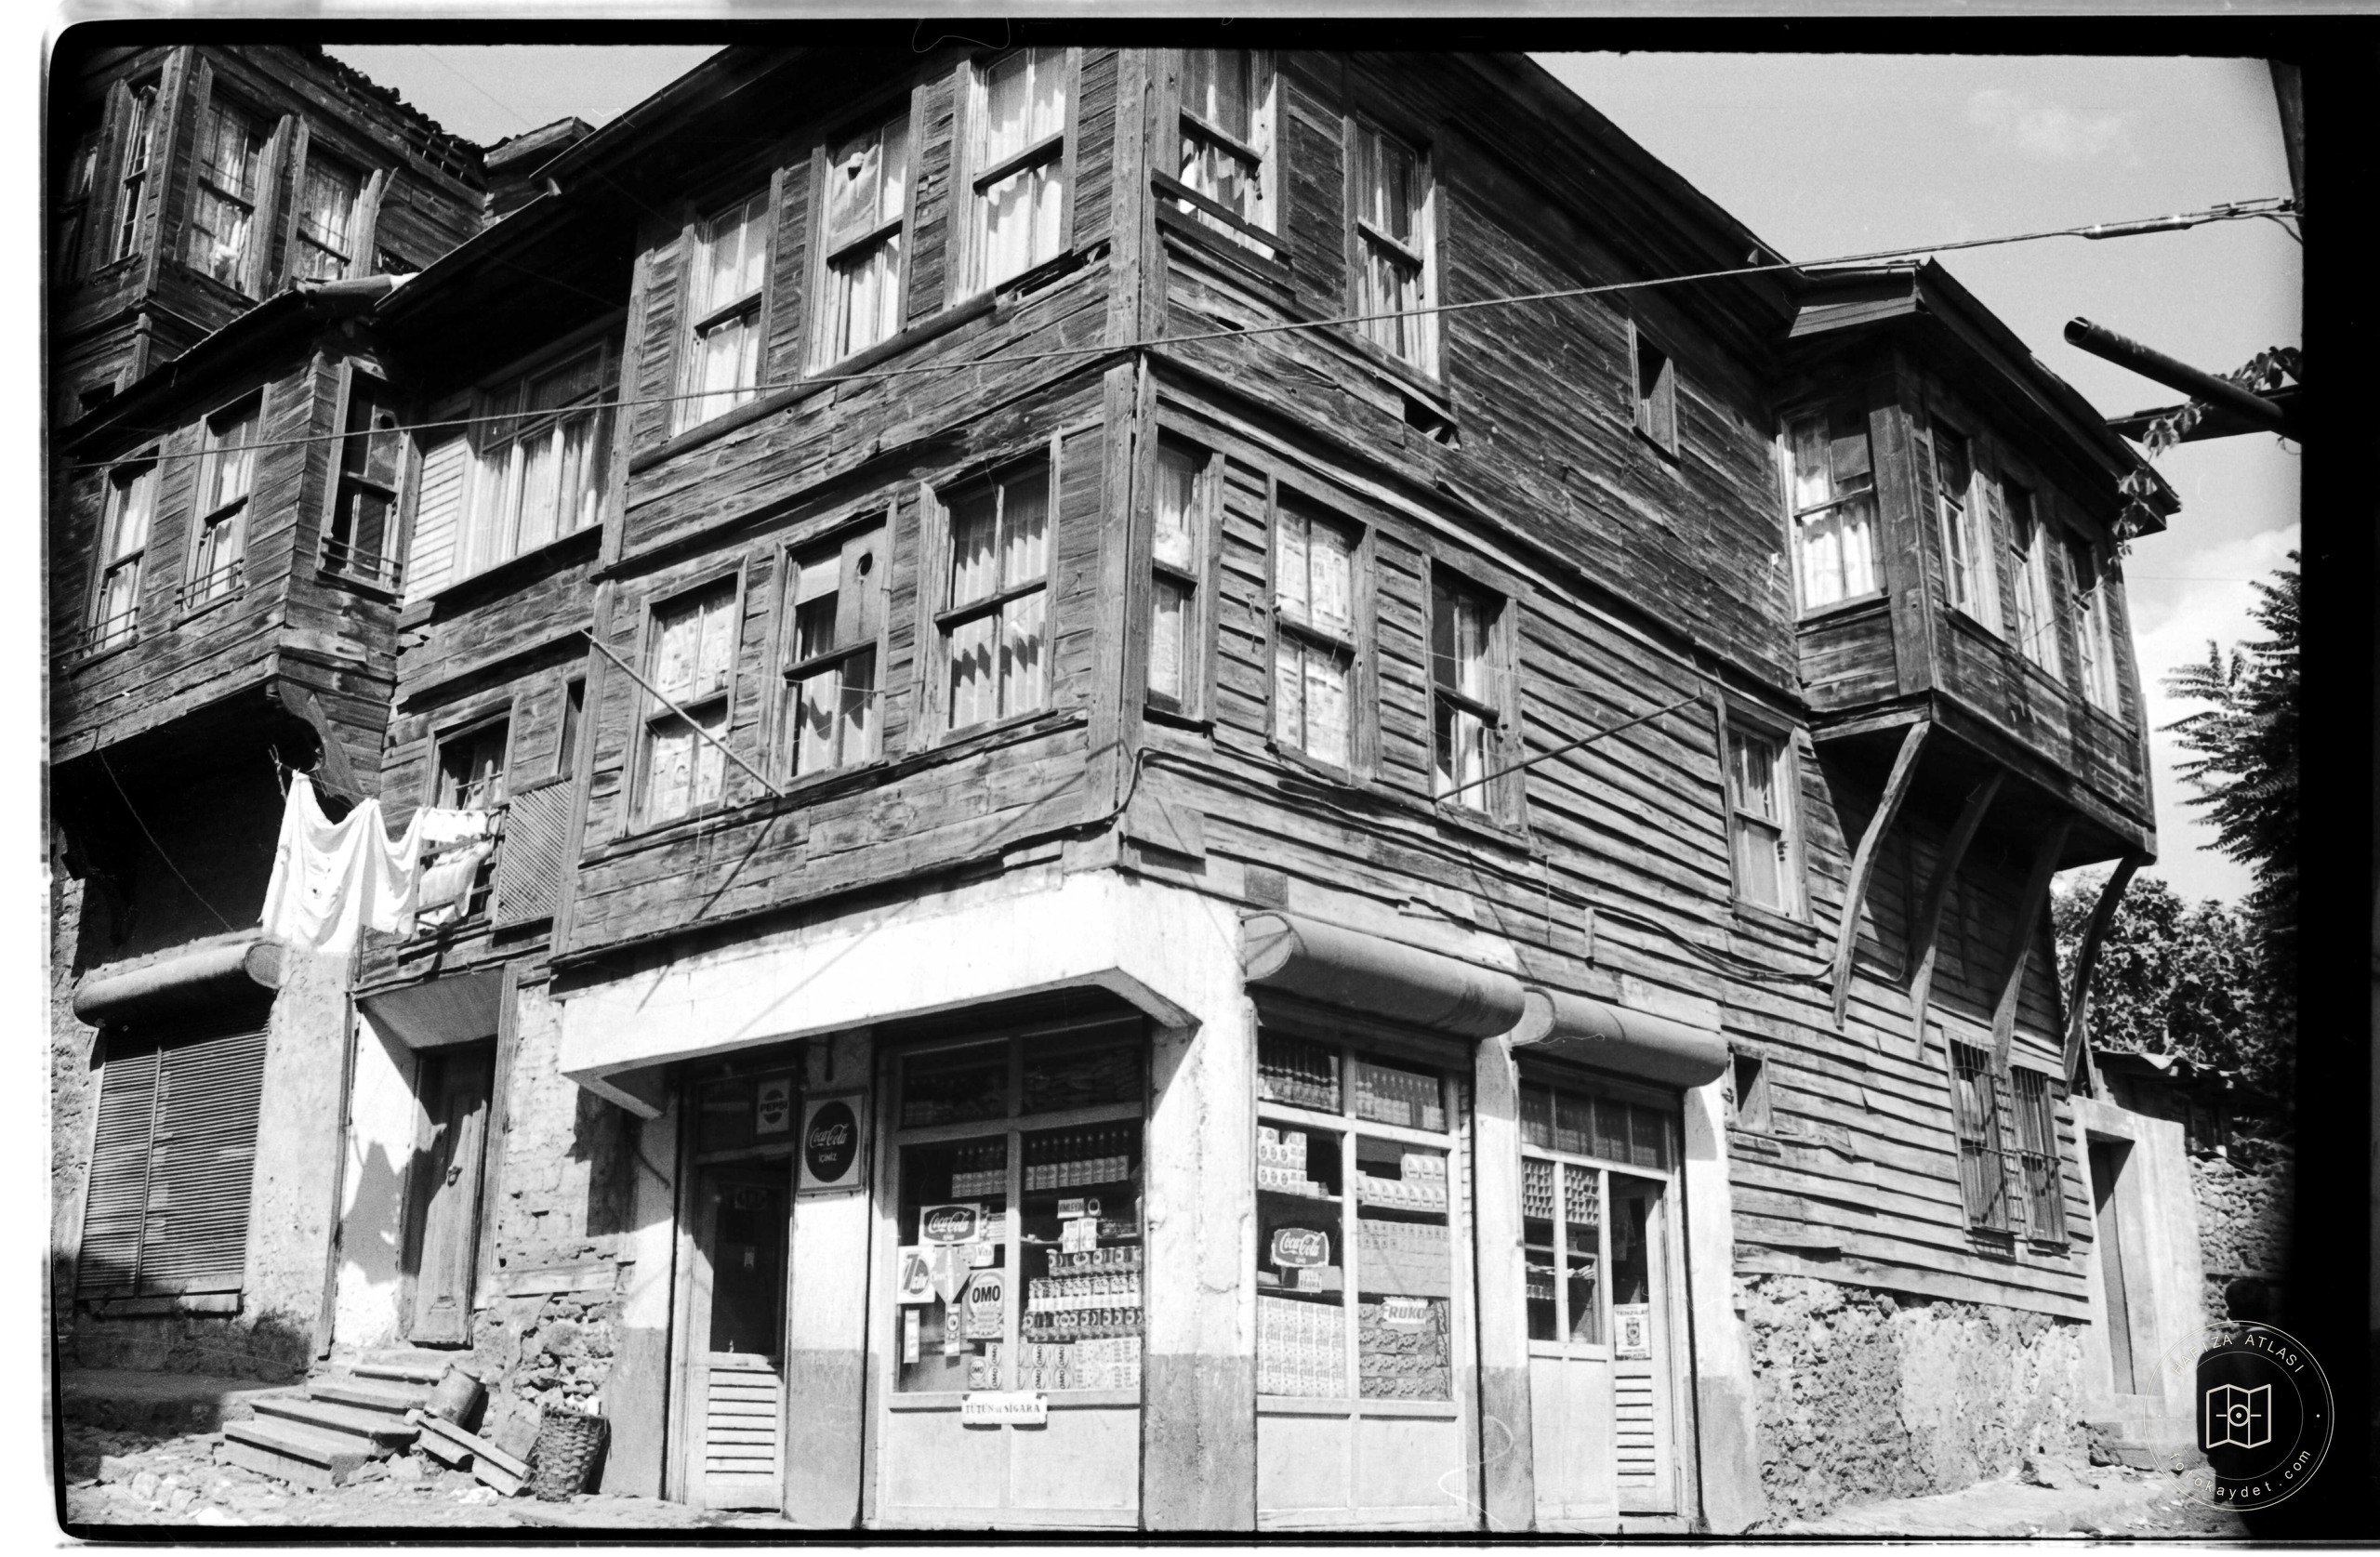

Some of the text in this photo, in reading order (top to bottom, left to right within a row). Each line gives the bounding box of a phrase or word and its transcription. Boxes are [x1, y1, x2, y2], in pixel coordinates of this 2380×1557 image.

[760, 1101, 788, 1113] PEPSI
[972, 1285, 1001, 1303] OMO
[1382, 1303, 1427, 1320] FRUKO
[965, 1402, 994, 1414] TÜTÜN
[1004, 1402, 1041, 1414] SİGARA
